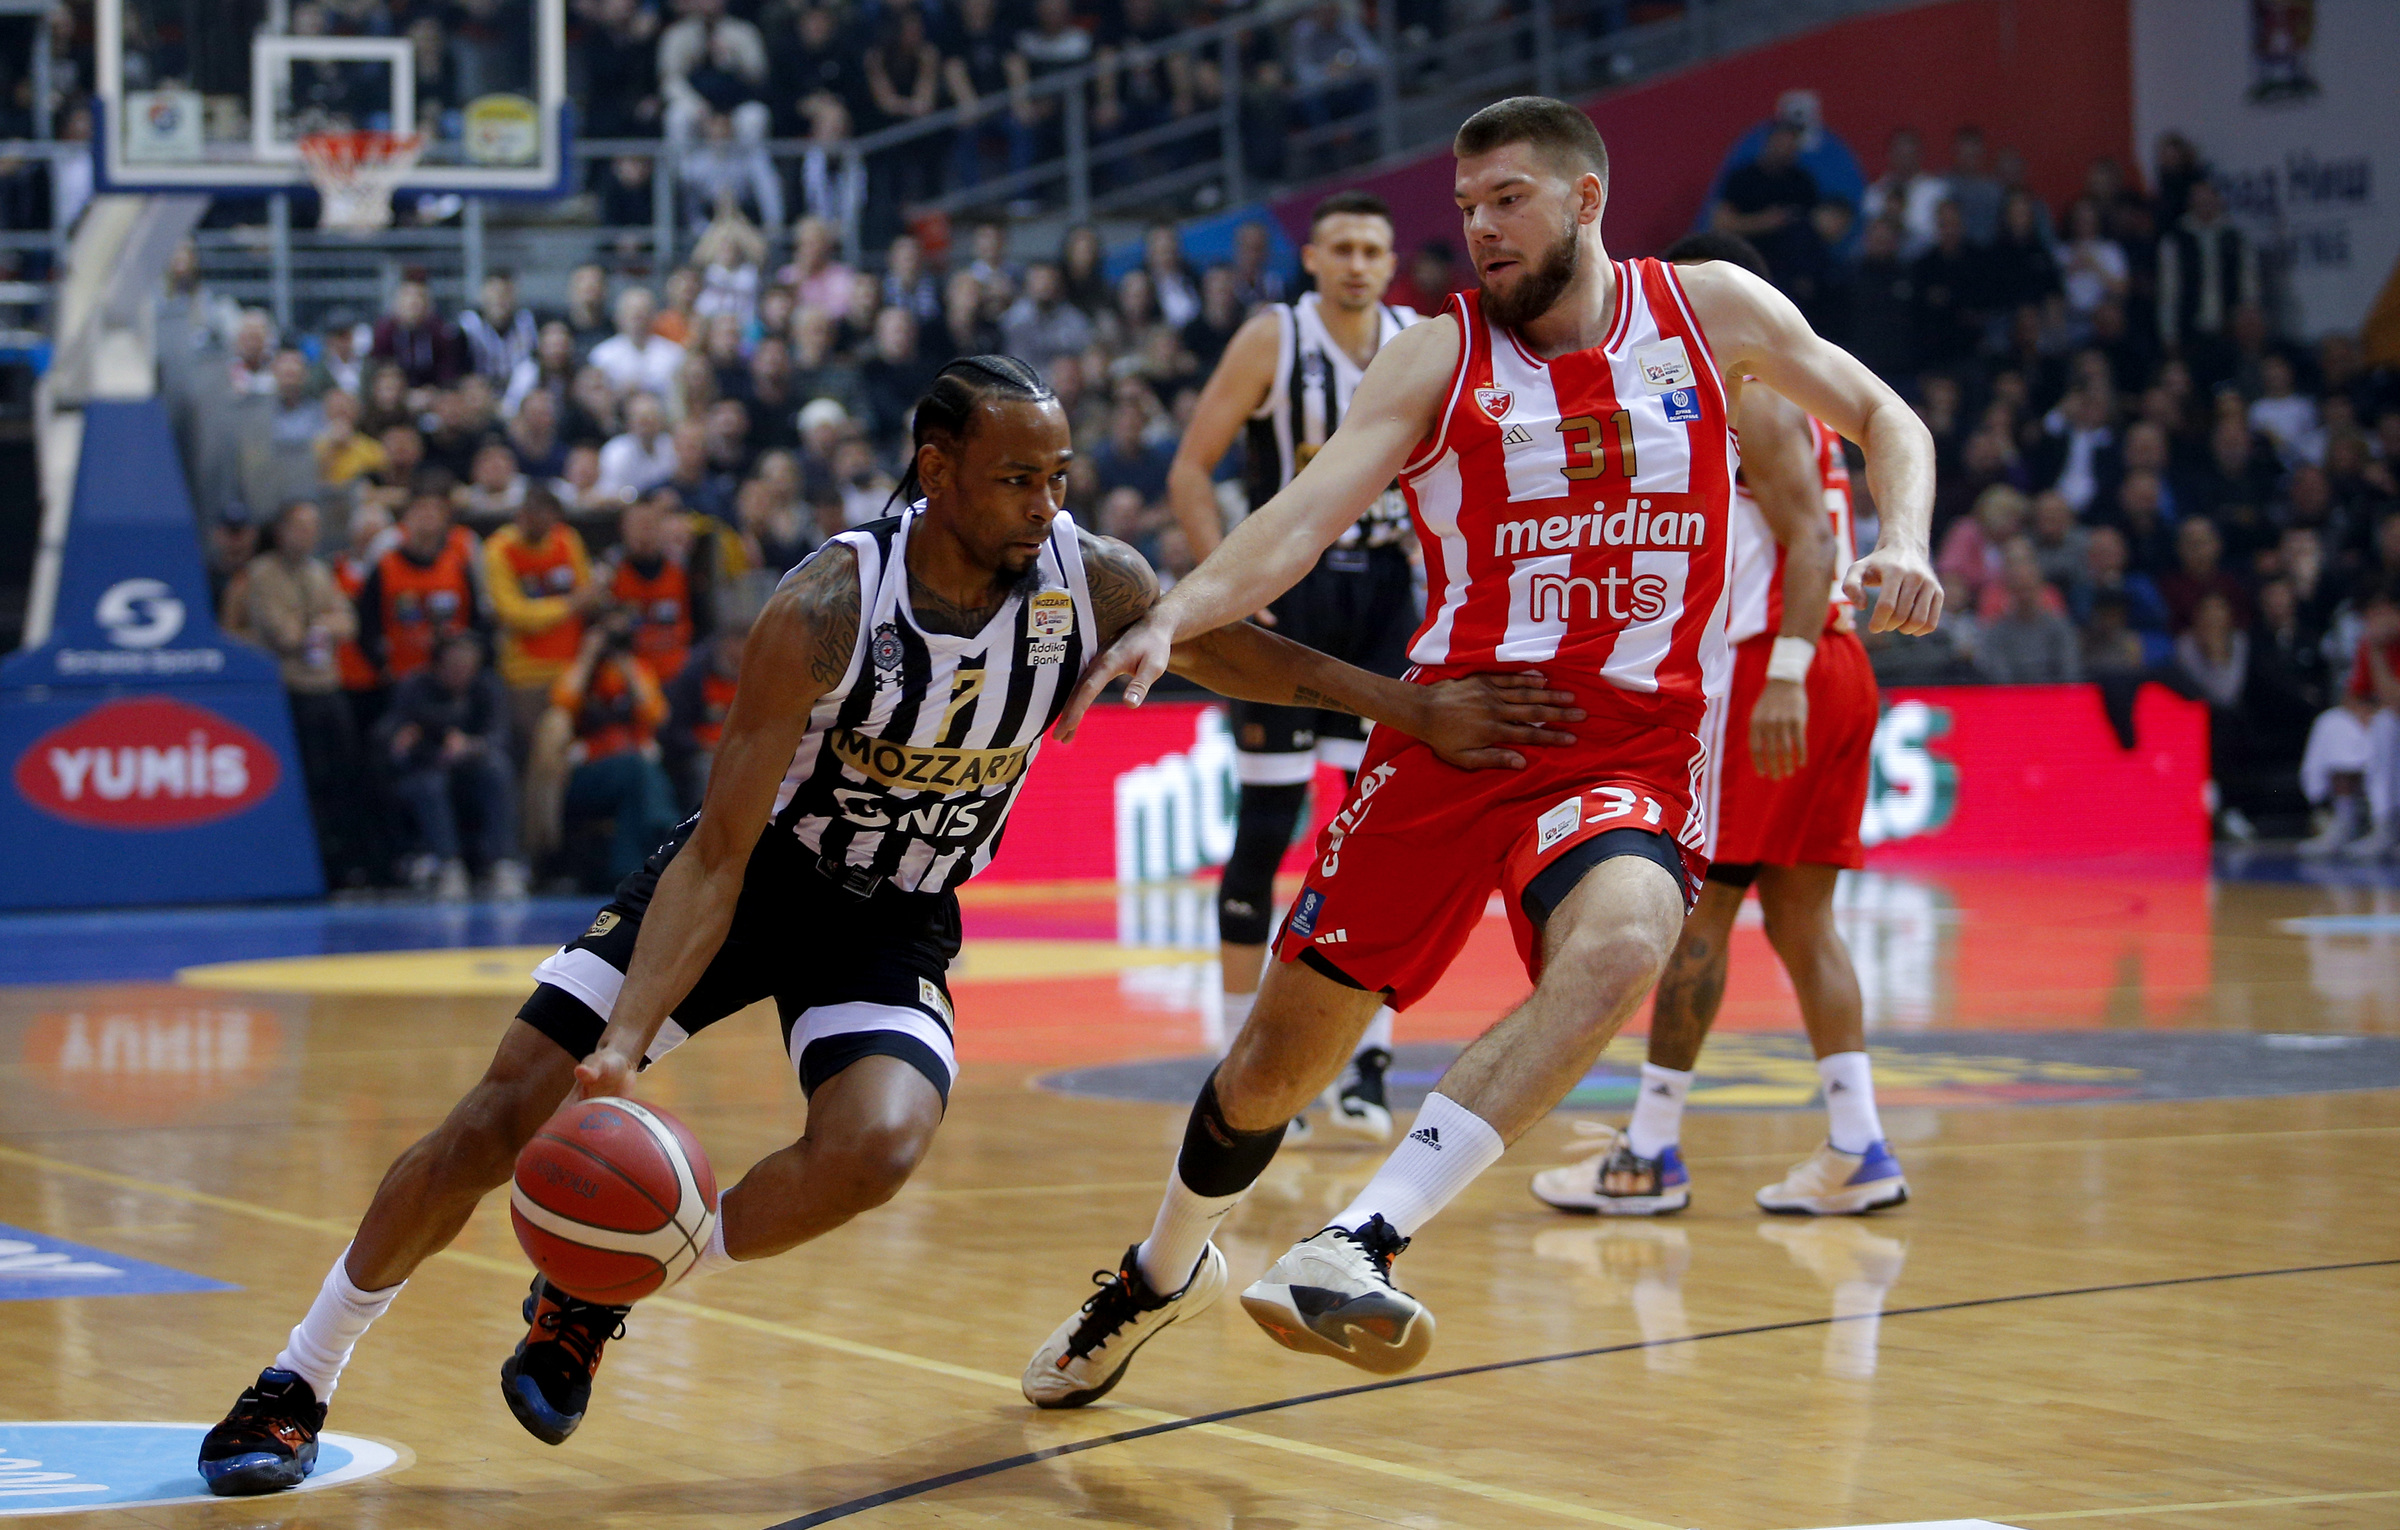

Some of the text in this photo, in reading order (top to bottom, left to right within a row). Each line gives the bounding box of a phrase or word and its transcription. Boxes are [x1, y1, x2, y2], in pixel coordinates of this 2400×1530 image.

[1555, 409, 1637, 481] 31
[1494, 498, 1706, 557] meridian
[1035, 598, 1070, 607] MOZZART
[1530, 566, 1668, 623] mts
[1030, 642, 1066, 654] Addiko
[1033, 654, 1059, 665] Bank
[934, 668, 987, 743] 7
[835, 729, 1027, 787] MOZZART
[896, 800, 987, 837] NIS
[1585, 786, 1663, 825] 31
[1410, 1131, 1443, 1151] adidas
